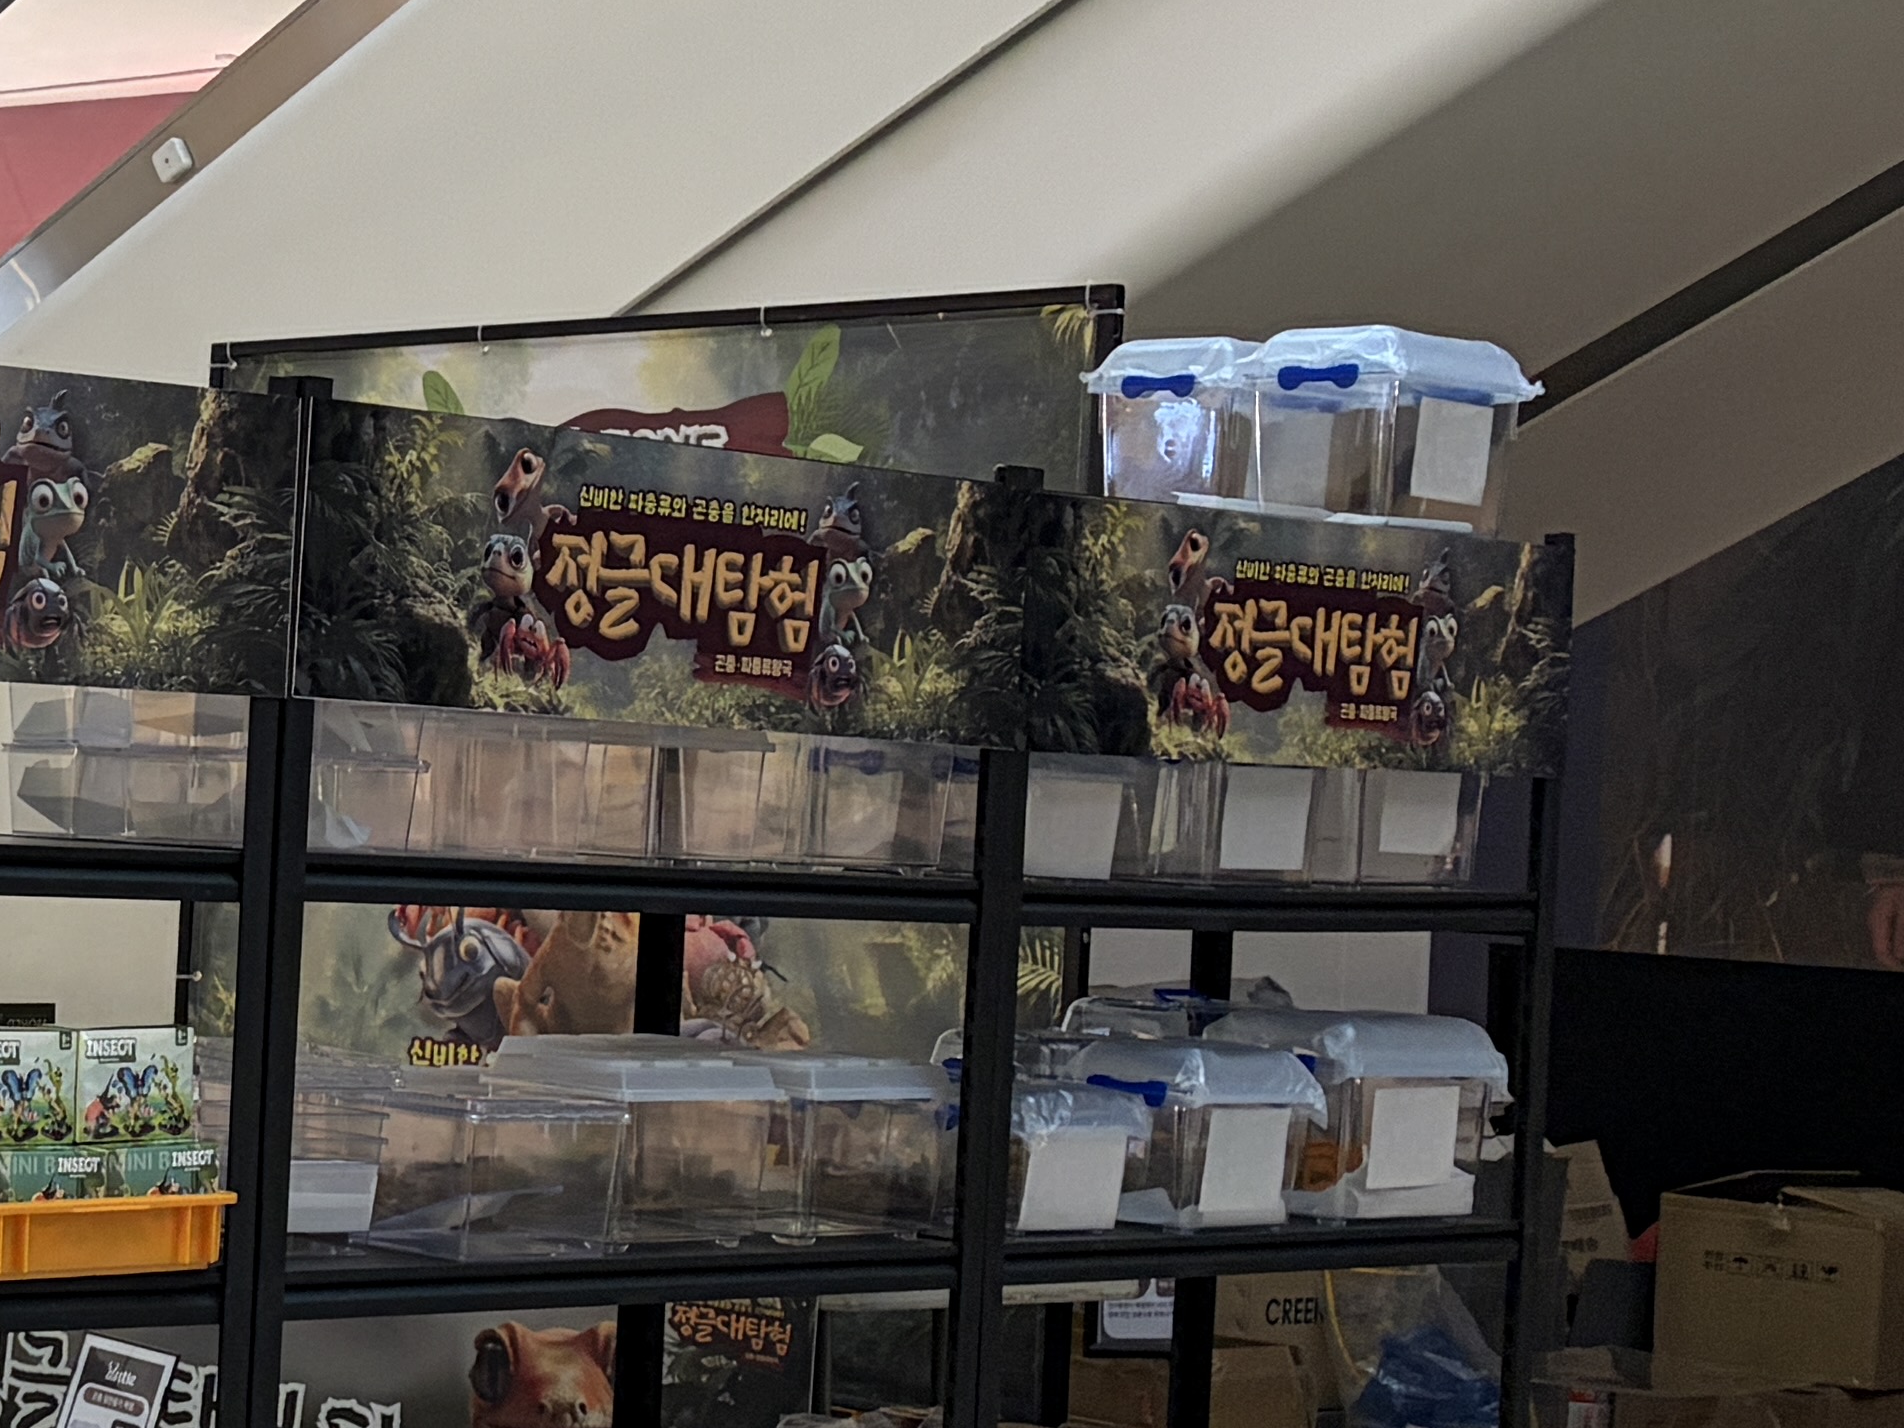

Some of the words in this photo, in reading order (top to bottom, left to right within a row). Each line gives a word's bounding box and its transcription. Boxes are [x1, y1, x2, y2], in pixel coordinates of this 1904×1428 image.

[545, 530, 819, 653] 정글대탐험
[1208, 598, 1419, 700] 정글대탐험
[85, 1037, 135, 1058] INSECT
[407, 1038, 482, 1067] 신비한
[57, 1156, 100, 1174] INSECT
[171, 1149, 214, 1168] INSECT
[672, 1305, 792, 1356] 정글대탐험
